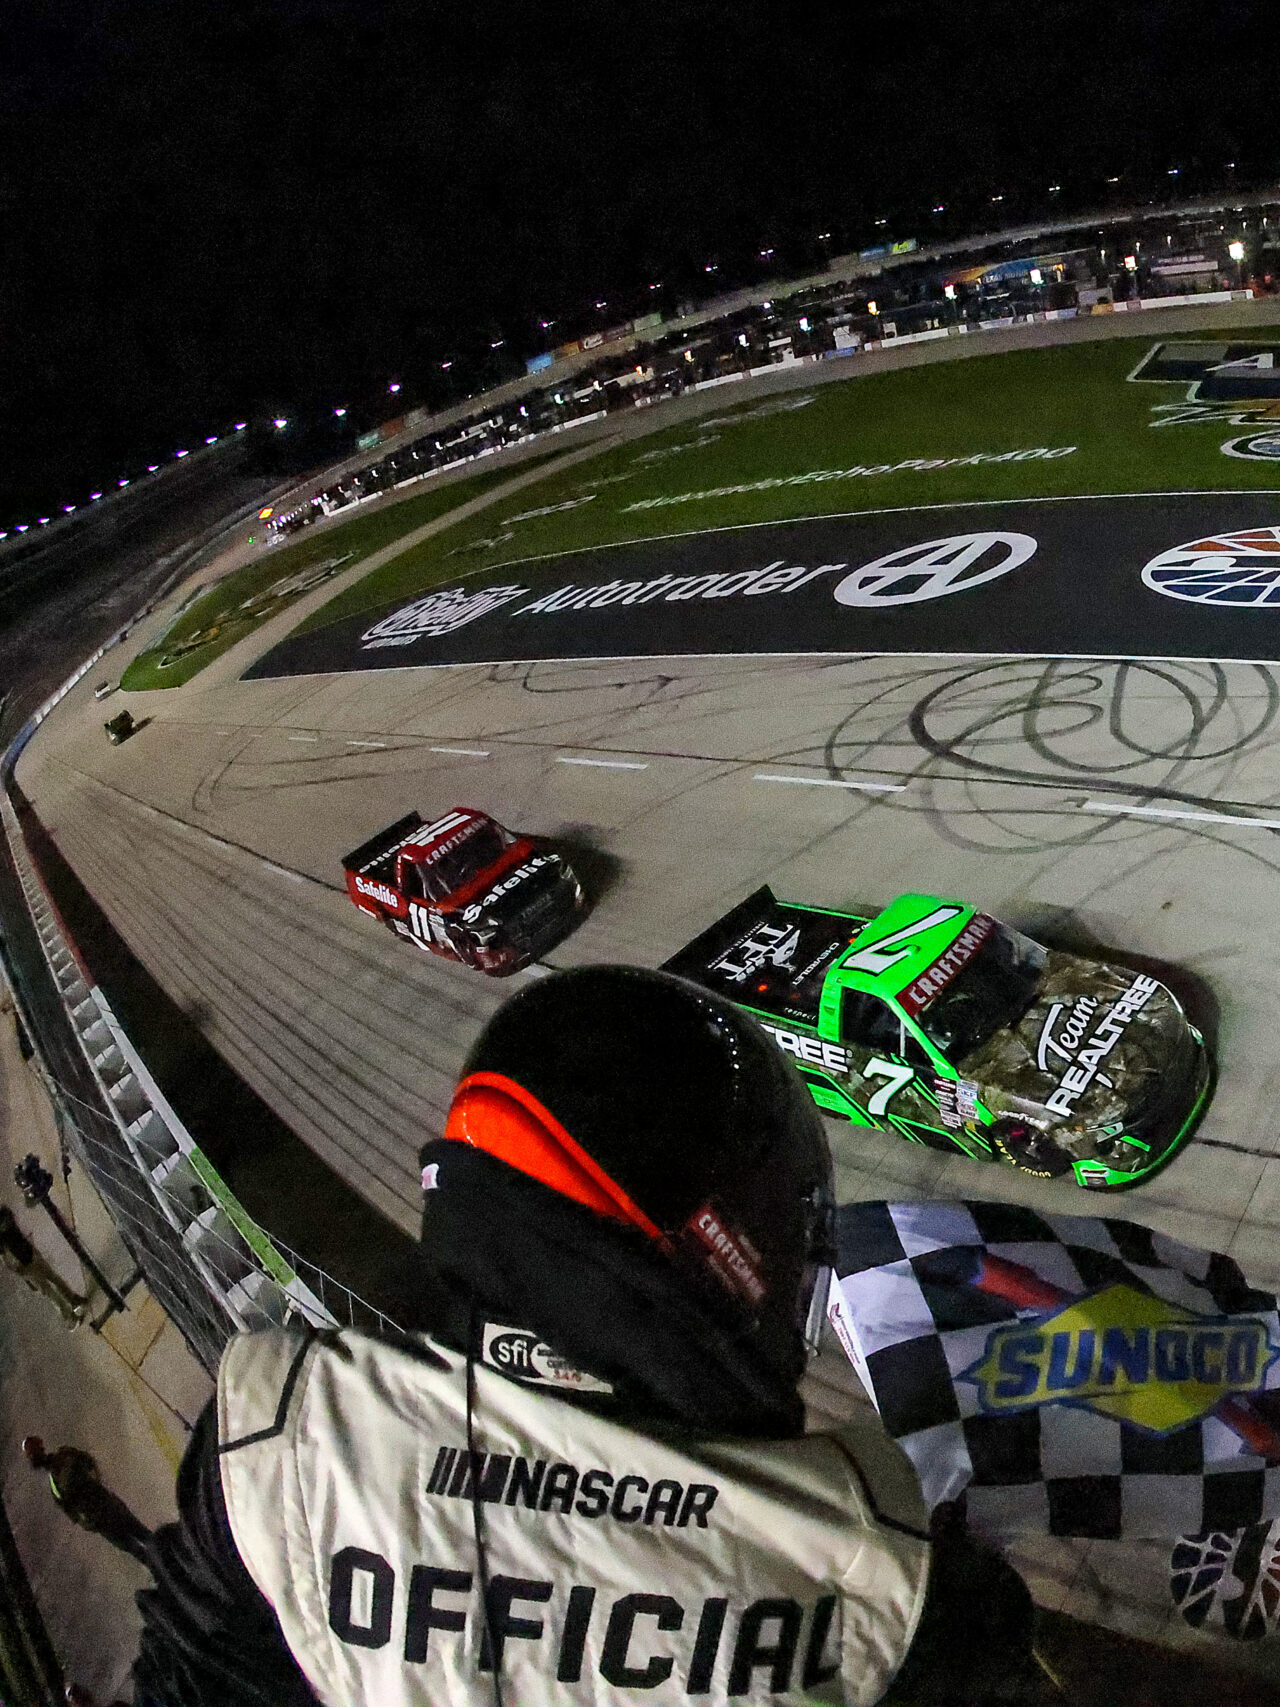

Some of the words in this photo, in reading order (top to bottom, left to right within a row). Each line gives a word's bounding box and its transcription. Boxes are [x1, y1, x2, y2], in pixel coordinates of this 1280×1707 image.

[511, 560, 847, 616] Autotrader
[426, 817, 489, 865] CRAFTSMAN
[355, 876, 399, 908] Safelite
[462, 853, 561, 923] Safelite
[408, 902, 432, 942] 11
[713, 923, 795, 981] TFT
[840, 905, 964, 976] 7
[792, 942, 840, 986] CHEVROLET
[908, 913, 996, 1005] CRAFTSMAN
[1037, 994, 1113, 1088] Team
[1045, 973, 1160, 1118] REALTREE
[862, 1056, 915, 1116] 7
[497, 1339, 529, 1368] sfi
[996, 1326, 1261, 1401] SUNOCO
[507, 1455, 721, 1529] NASCAR
[328, 1546, 845, 1697] OFFICIAL
